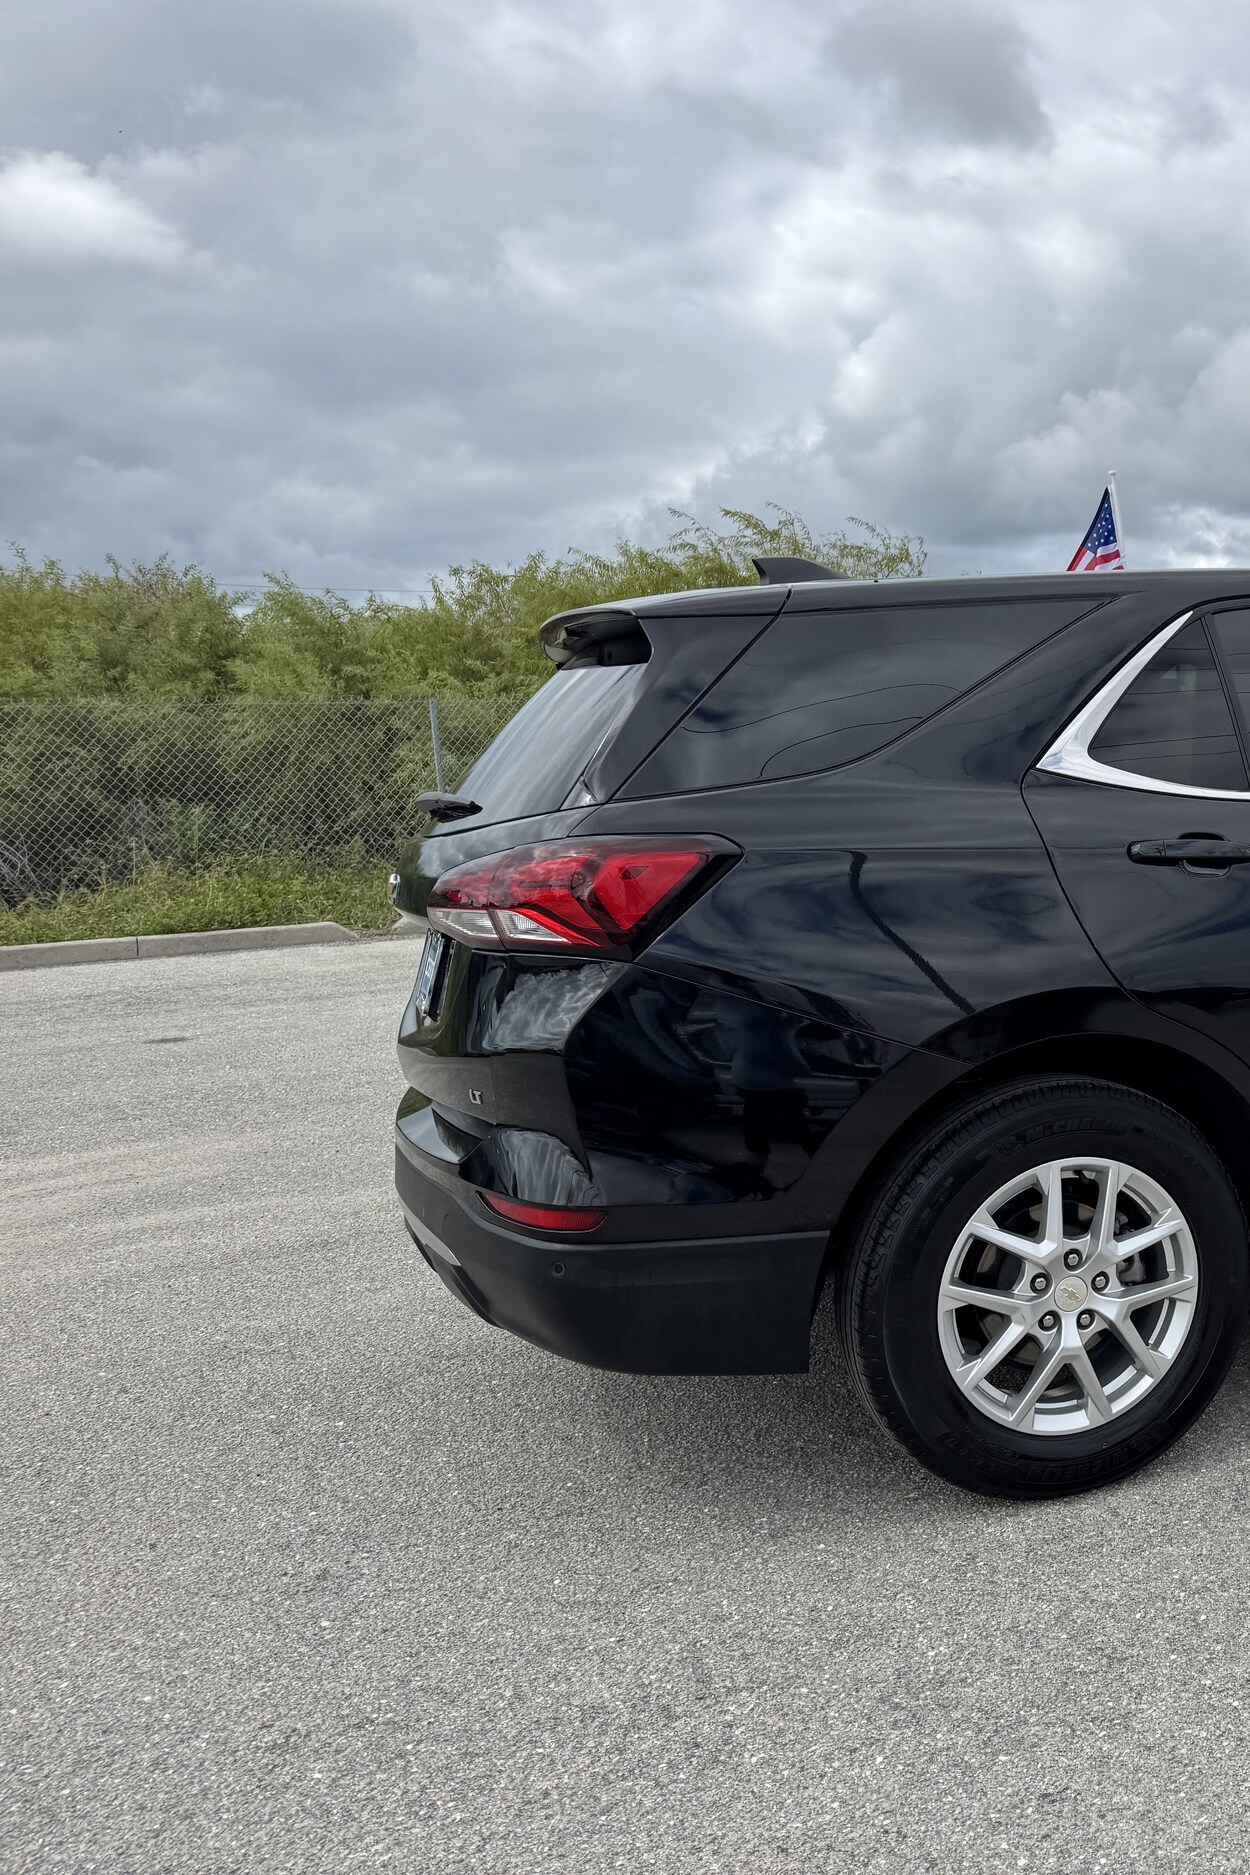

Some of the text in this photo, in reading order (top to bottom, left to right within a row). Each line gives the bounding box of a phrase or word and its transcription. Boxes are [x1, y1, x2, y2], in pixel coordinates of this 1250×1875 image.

[468, 1088, 482, 1105] LT
[1025, 1117, 1130, 1143] MICHELIN
[1026, 1447, 1129, 1482] MICHELIN
